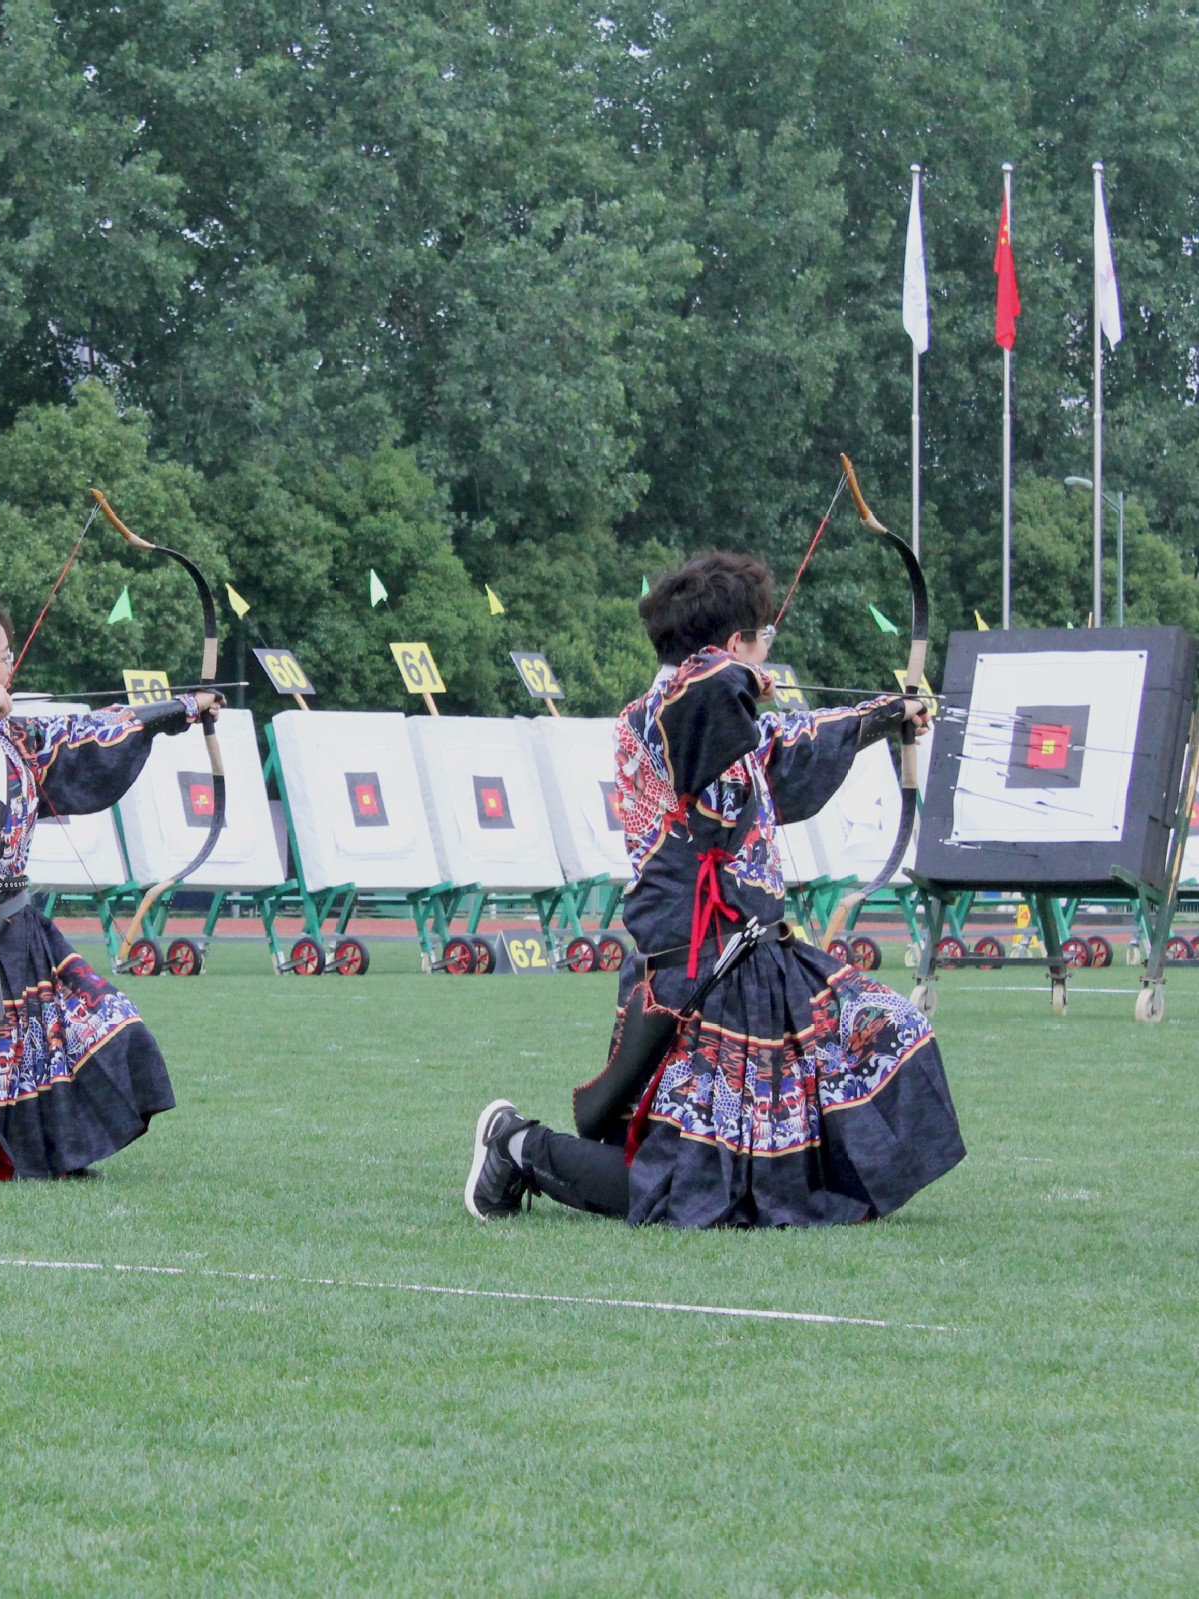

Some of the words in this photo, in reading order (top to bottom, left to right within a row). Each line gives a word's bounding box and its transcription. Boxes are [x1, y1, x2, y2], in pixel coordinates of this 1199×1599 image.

[264, 654, 307, 688] 60
[401, 650, 437, 686] 61
[520, 658, 560, 693] 62
[509, 938, 547, 968] 62
